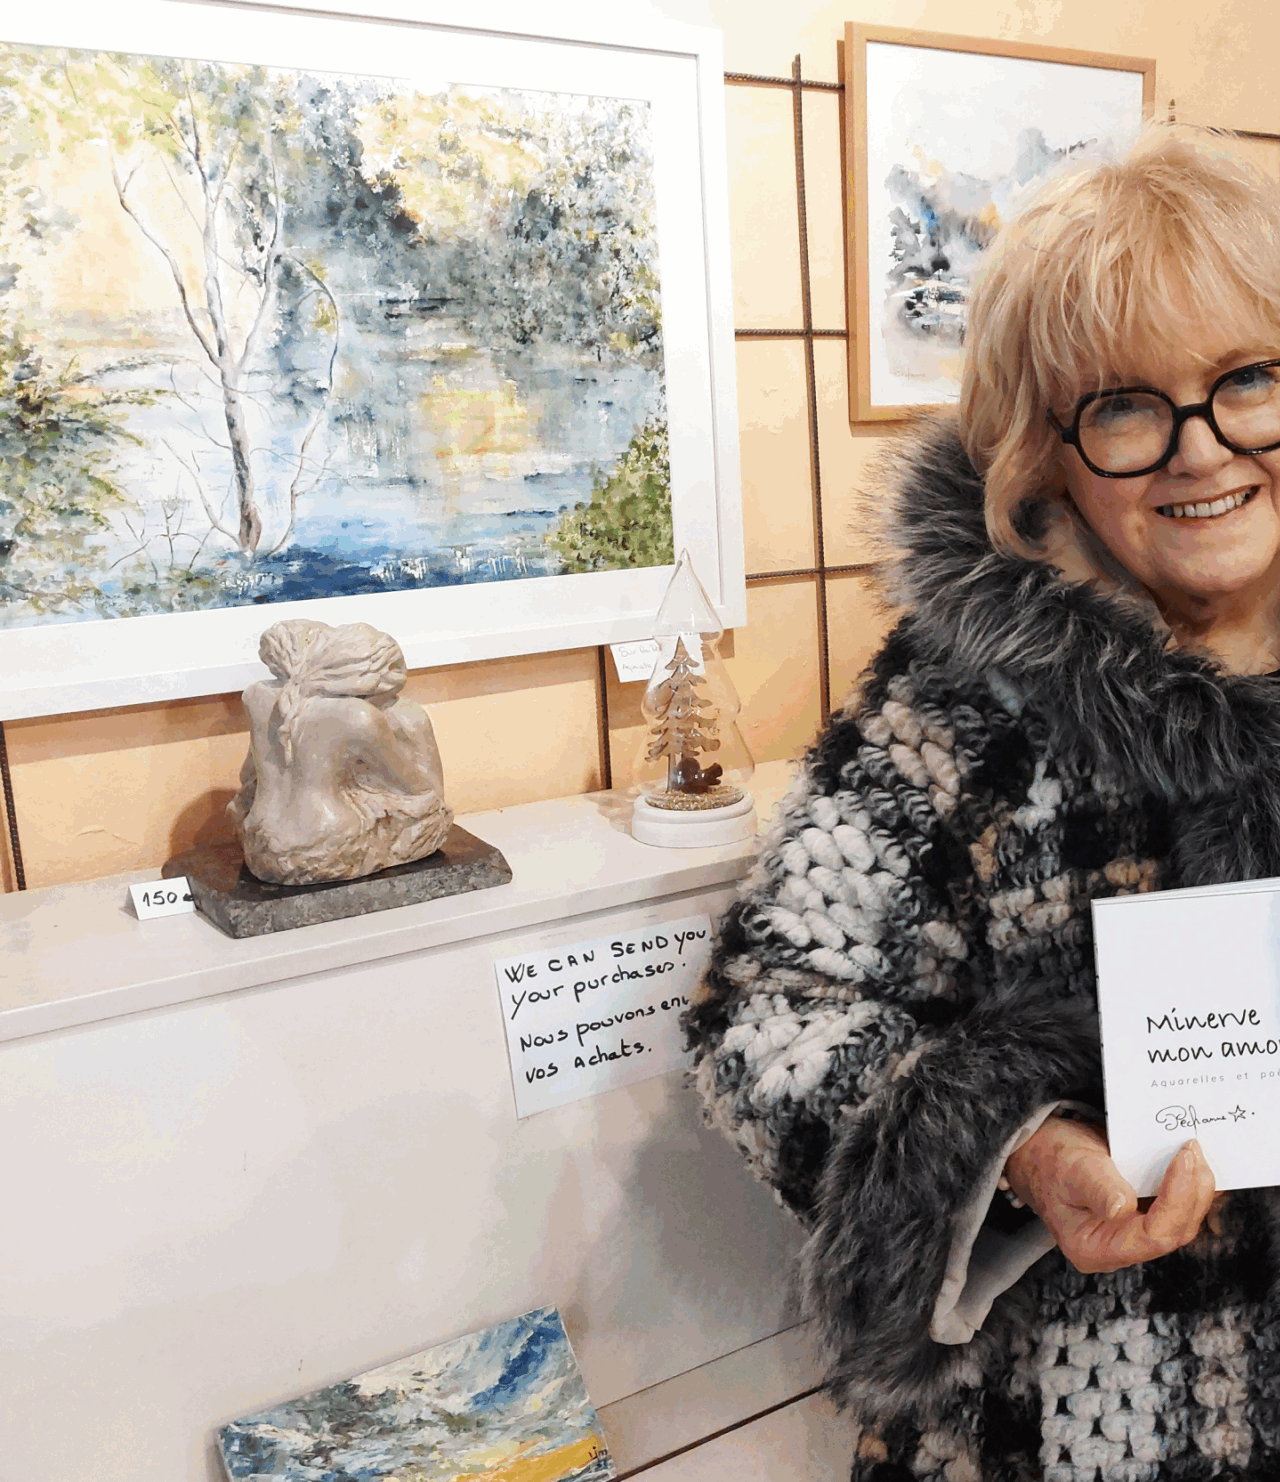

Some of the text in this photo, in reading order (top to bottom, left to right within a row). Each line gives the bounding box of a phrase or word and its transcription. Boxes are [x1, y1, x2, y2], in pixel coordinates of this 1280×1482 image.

[547, 950, 595, 972] CAN
[610, 935, 669, 958] SEND
[520, 1029, 568, 1052] Nous
[576, 1005, 656, 1047] pouvons
[1146, 1007, 1261, 1033] Minerve
[1147, 1046, 1213, 1064] mon
[1150, 1073, 1225, 1089] Aquarelles
[1236, 1071, 1249, 1081] et
